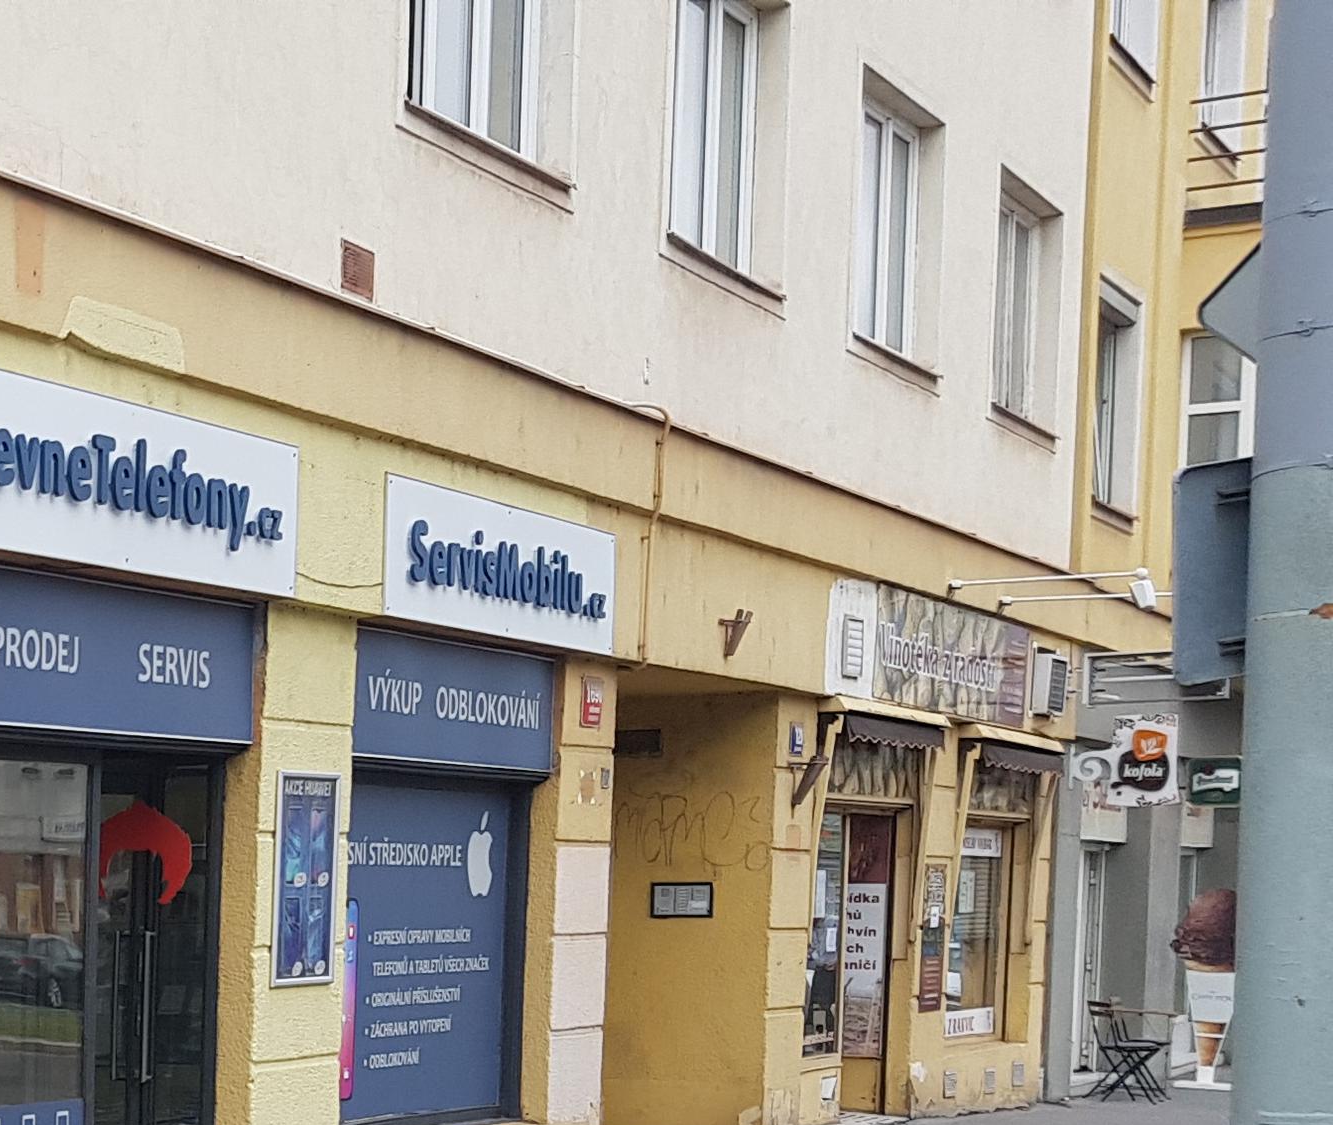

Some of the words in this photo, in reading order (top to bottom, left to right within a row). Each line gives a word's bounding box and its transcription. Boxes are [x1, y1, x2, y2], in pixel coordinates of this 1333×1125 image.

[408, 518, 607, 620] ServisMobilu.cz
[137, 642, 211, 690] SERVIS
[367, 668, 423, 716] VÝKUP
[435, 686, 542, 731] ODBLOKOVÁNÍ
[1122, 763, 1165, 782] kofola
[368, 836, 429, 867] STŘEDISKO
[429, 843, 463, 867] APPLE
[847, 892, 880, 904] ídka
